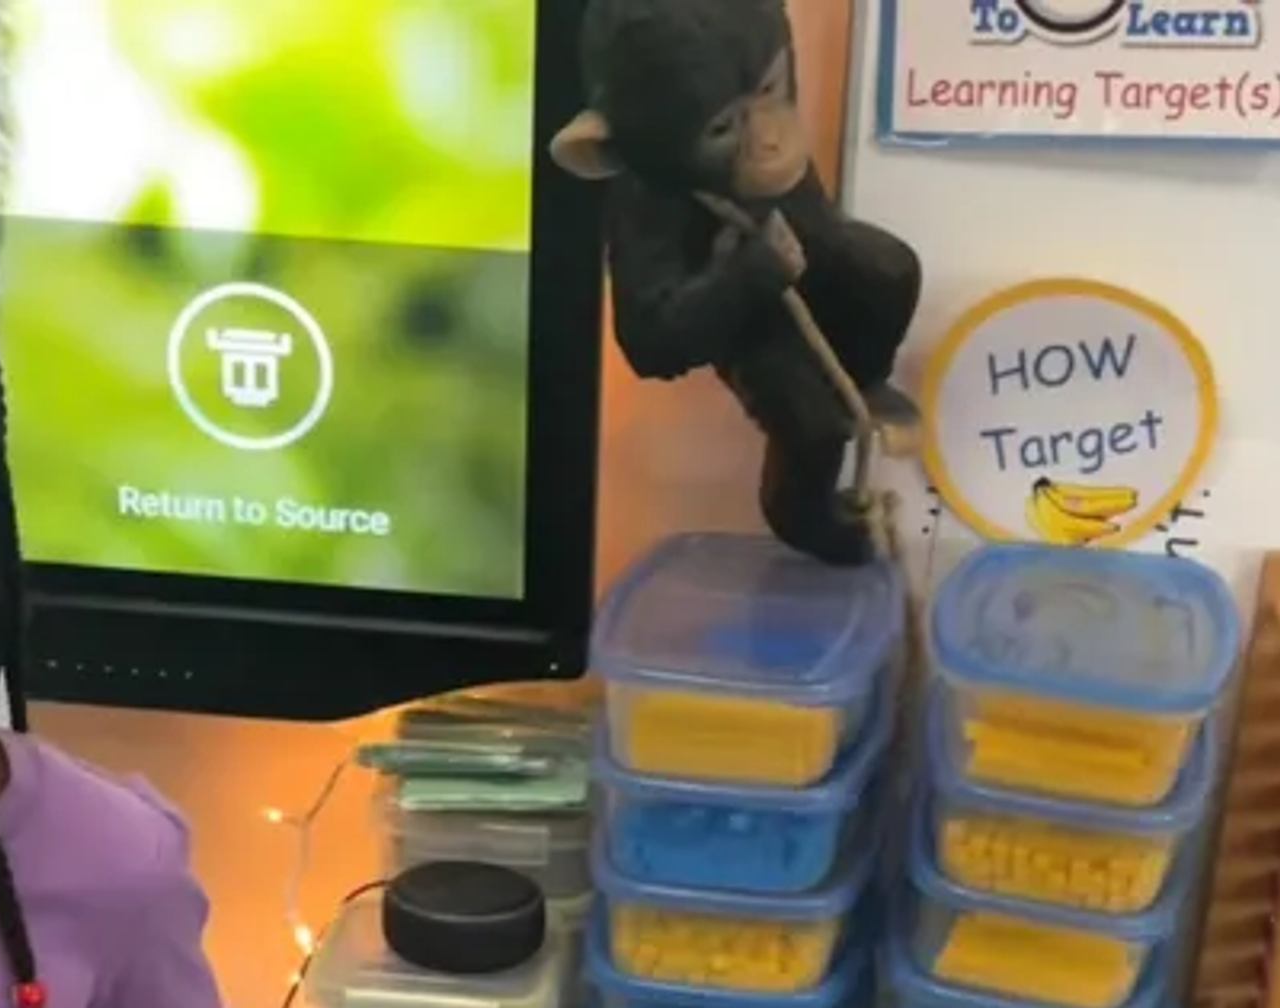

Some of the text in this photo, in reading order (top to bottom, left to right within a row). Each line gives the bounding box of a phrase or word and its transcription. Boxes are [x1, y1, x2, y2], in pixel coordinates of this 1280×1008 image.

[970, 0, 1250, 36] To Learn
[906, 70, 1078, 119] Learning
[987, 333, 1137, 395] HOW
[980, 409, 1164, 474] Target
[118, 485, 391, 535] Return to Source
